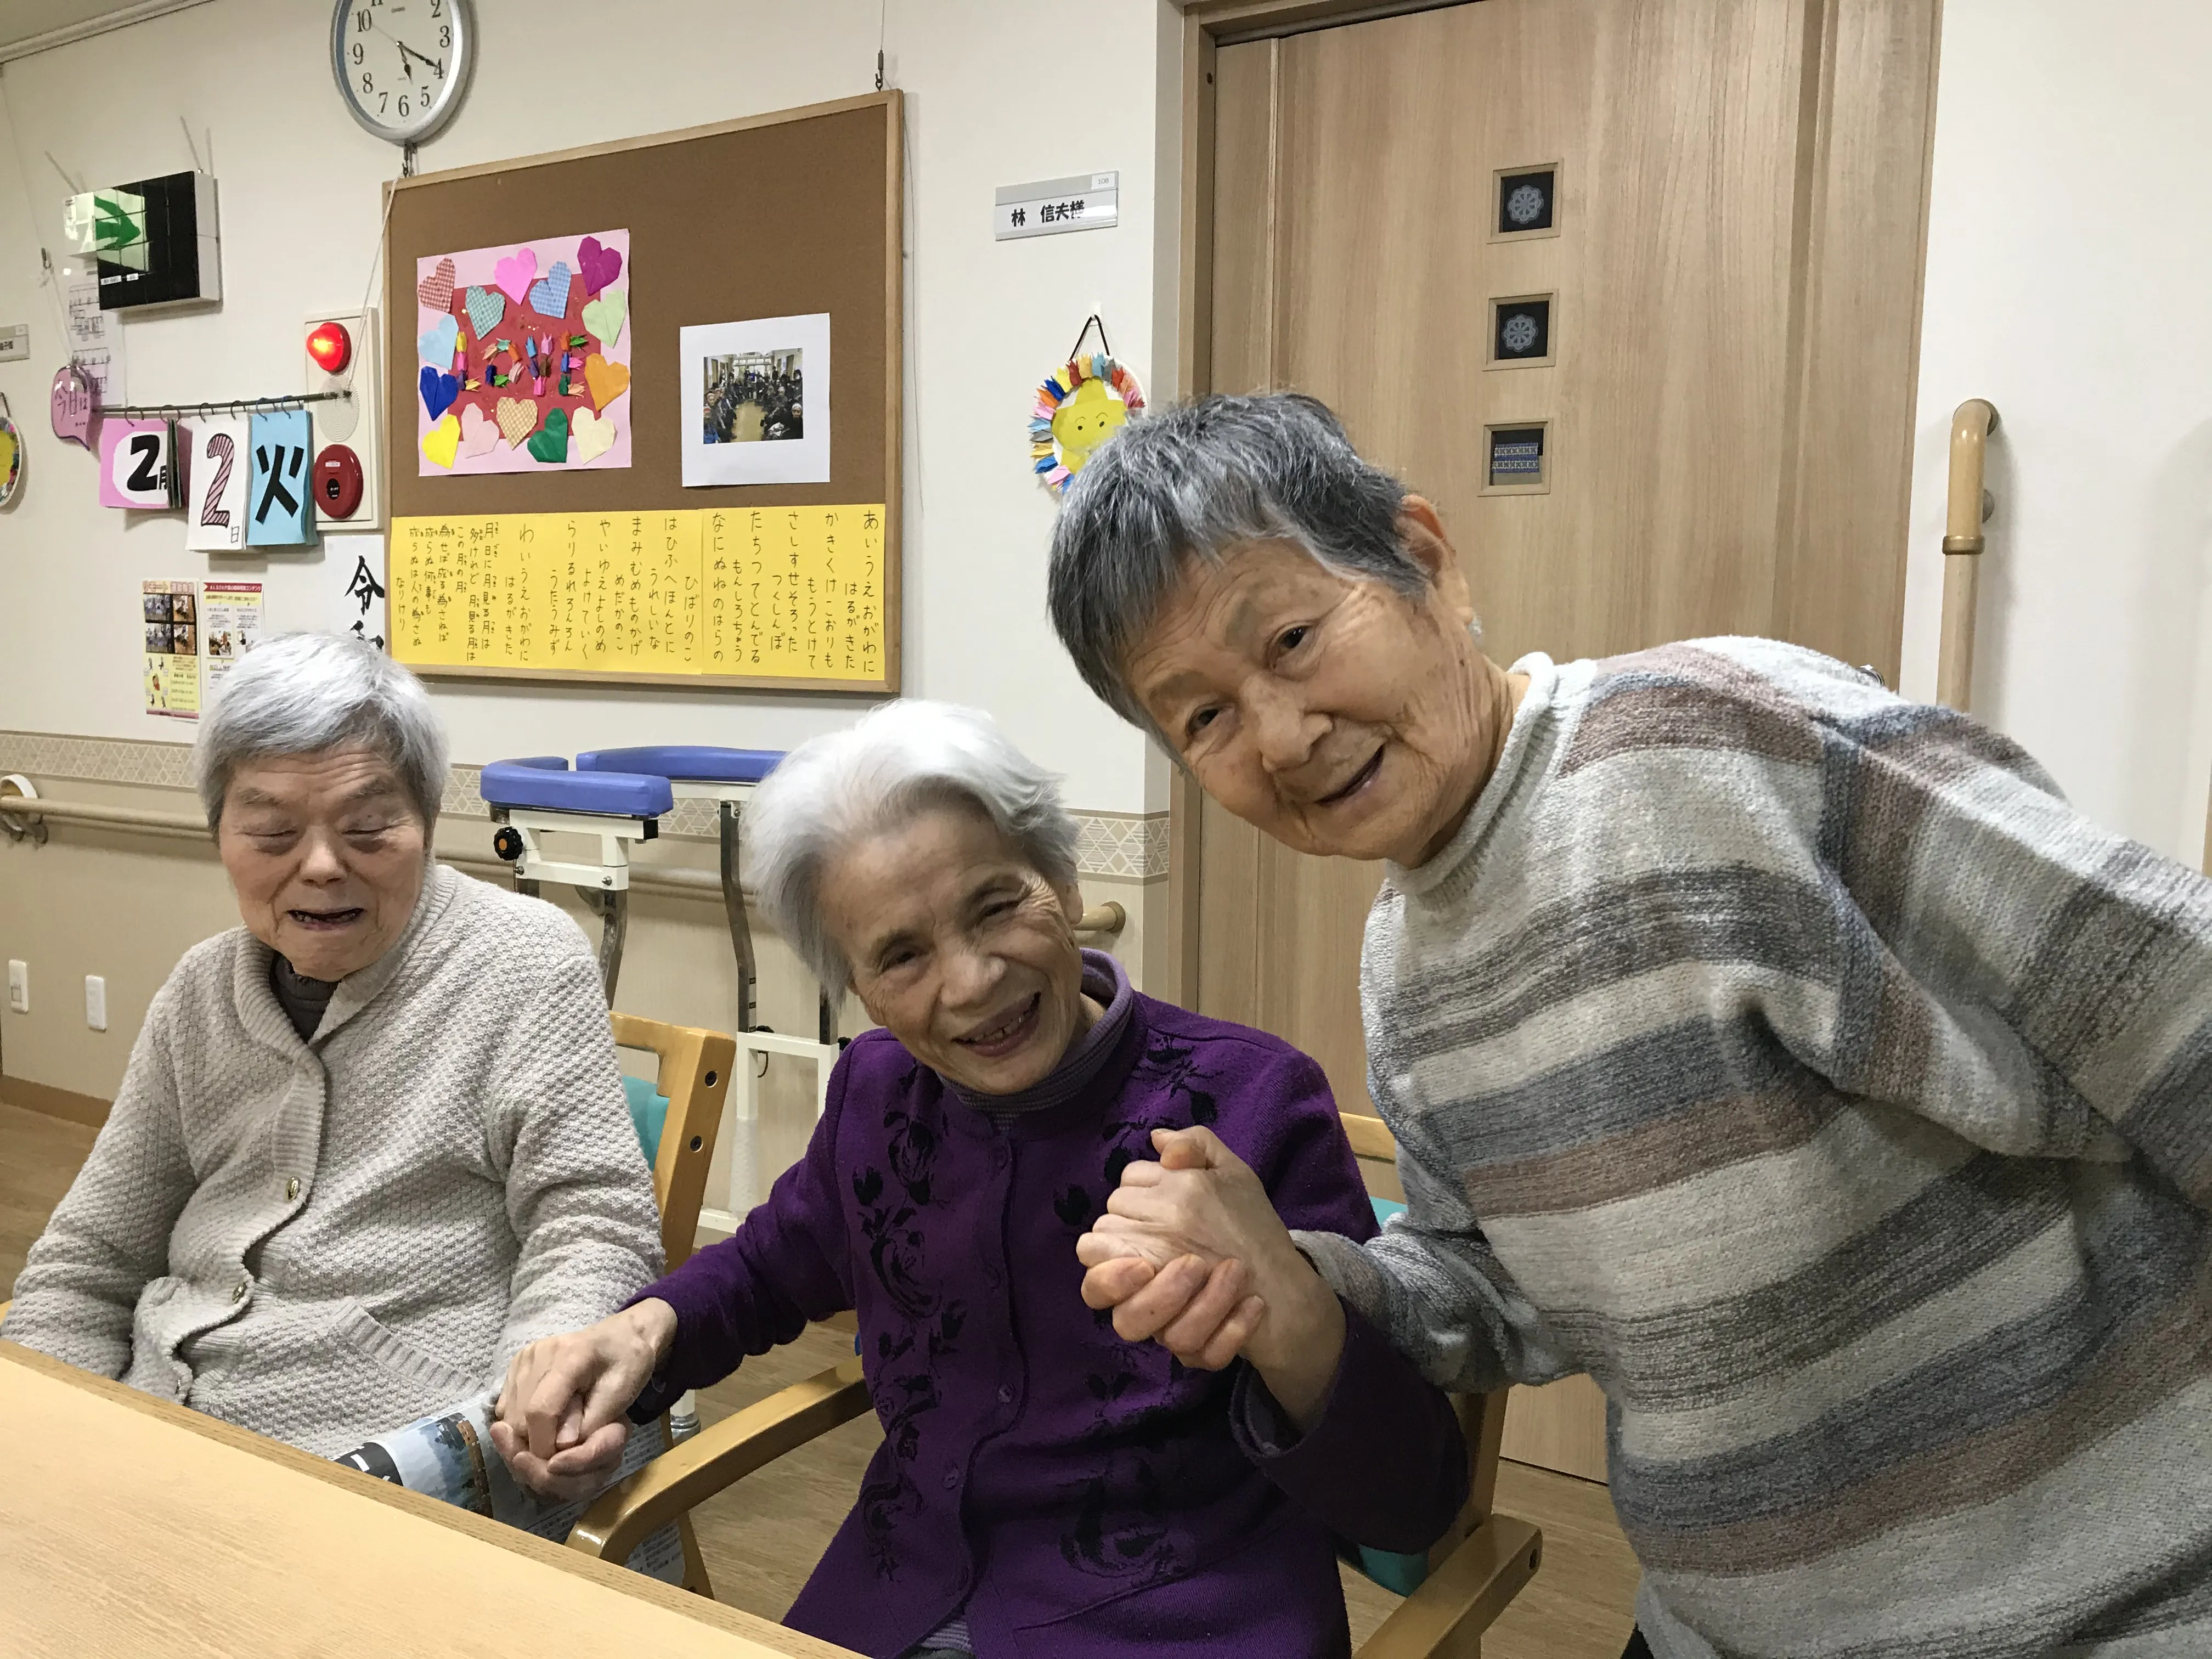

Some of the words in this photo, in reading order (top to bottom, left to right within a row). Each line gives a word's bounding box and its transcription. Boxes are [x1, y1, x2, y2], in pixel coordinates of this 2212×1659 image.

[353, 43, 363, 65] 9
[357, 9, 372, 32] 10
[439, 25, 450, 48] 3
[363, 72, 373, 93] 8
[379, 92, 388, 113] 7
[398, 95, 409, 117] 6
[420, 86, 430, 107] 5
[433, 58, 444, 79] 4
[1011, 208, 1025, 227] 林
[256, 445, 304, 524] 火
[396, 577, 406, 631] なりけり
[505, 575, 517, 655] はるがきた
[519, 523, 534, 661] わいうえおがわに
[549, 569, 561, 656] うたうみず
[565, 520, 577, 652] らりるれろんろん
[580, 568, 592, 660] よけていく
[595, 519, 611, 653] やいゆえよしのめ
[614, 574, 625, 651] めだかのこ
[629, 516, 643, 656] まみむめものかげ
[648, 568, 661, 650] うれしいな
[664, 516, 678, 653] はひふへほんとに
[684, 575, 700, 662] ひばりのこ
[712, 512, 727, 663] なにぬねのはらの
[750, 510, 763, 663] たちつてとんでる
[770, 574, 786, 651] つくしんぼ
[788, 511, 800, 653] さしすせそろった
[807, 577, 817, 670] もうとけて
[824, 512, 839, 668] かきくけこおりも
[862, 509, 879, 673] あいうえおがわに
[844, 582, 860, 669] はるがきた
